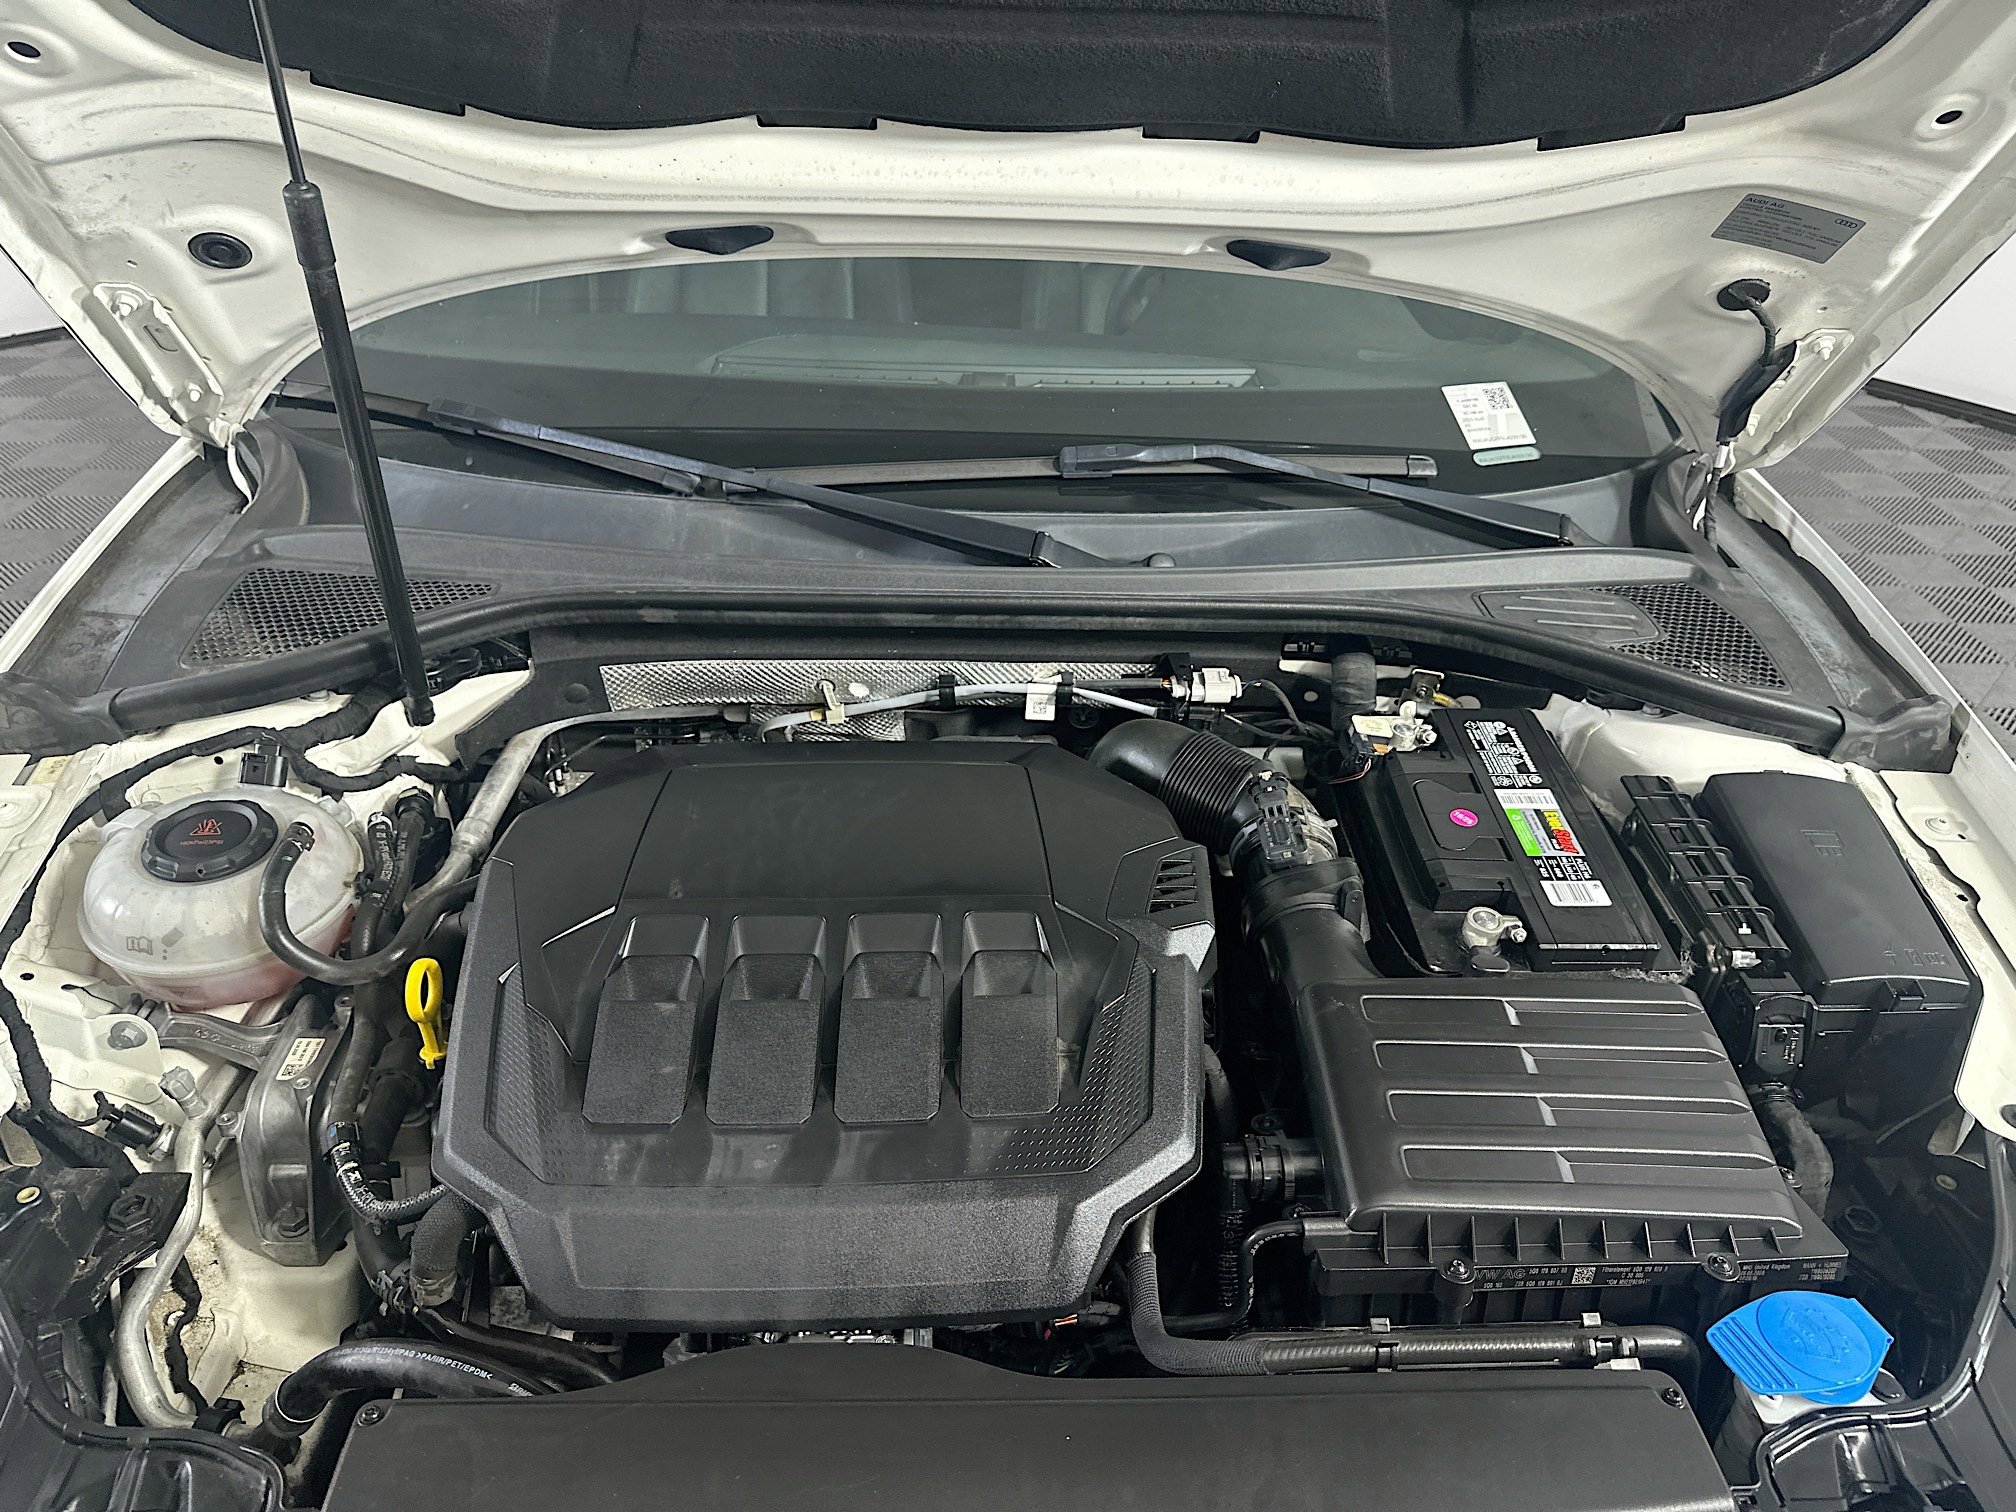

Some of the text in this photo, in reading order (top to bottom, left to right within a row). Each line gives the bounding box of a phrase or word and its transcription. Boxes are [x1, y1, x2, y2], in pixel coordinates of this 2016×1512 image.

[1746, 197, 1769, 206] AUDI
[1543, 811, 1580, 855] EverStart
[1771, 1263, 1791, 1271] Kingdom
[1475, 1268, 1526, 1280] VW AG
